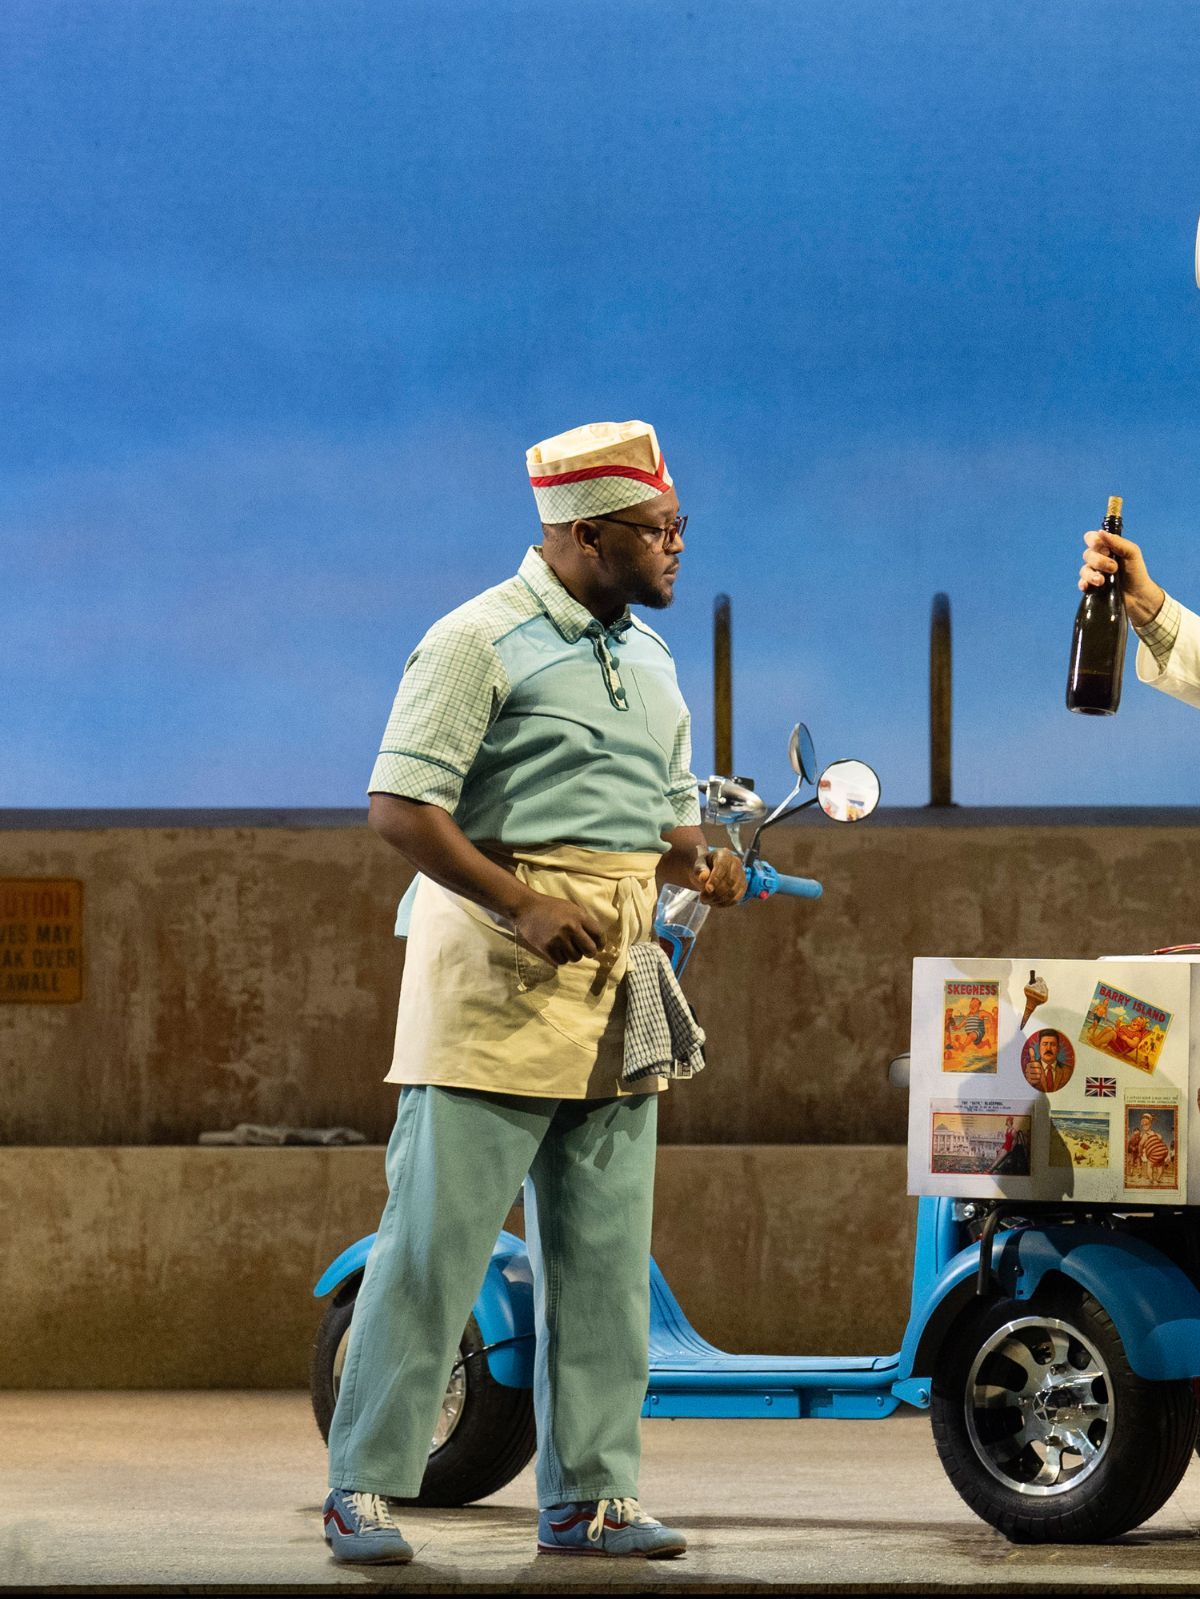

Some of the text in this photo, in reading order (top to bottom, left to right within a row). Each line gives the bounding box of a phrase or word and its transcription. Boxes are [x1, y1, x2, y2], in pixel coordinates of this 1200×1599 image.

[36, 924, 73, 945] MAY
[33, 948, 76, 968] OVER
[947, 984, 998, 996] SKEGNESS
[1099, 986, 1166, 1023] BARRY ISLAND
